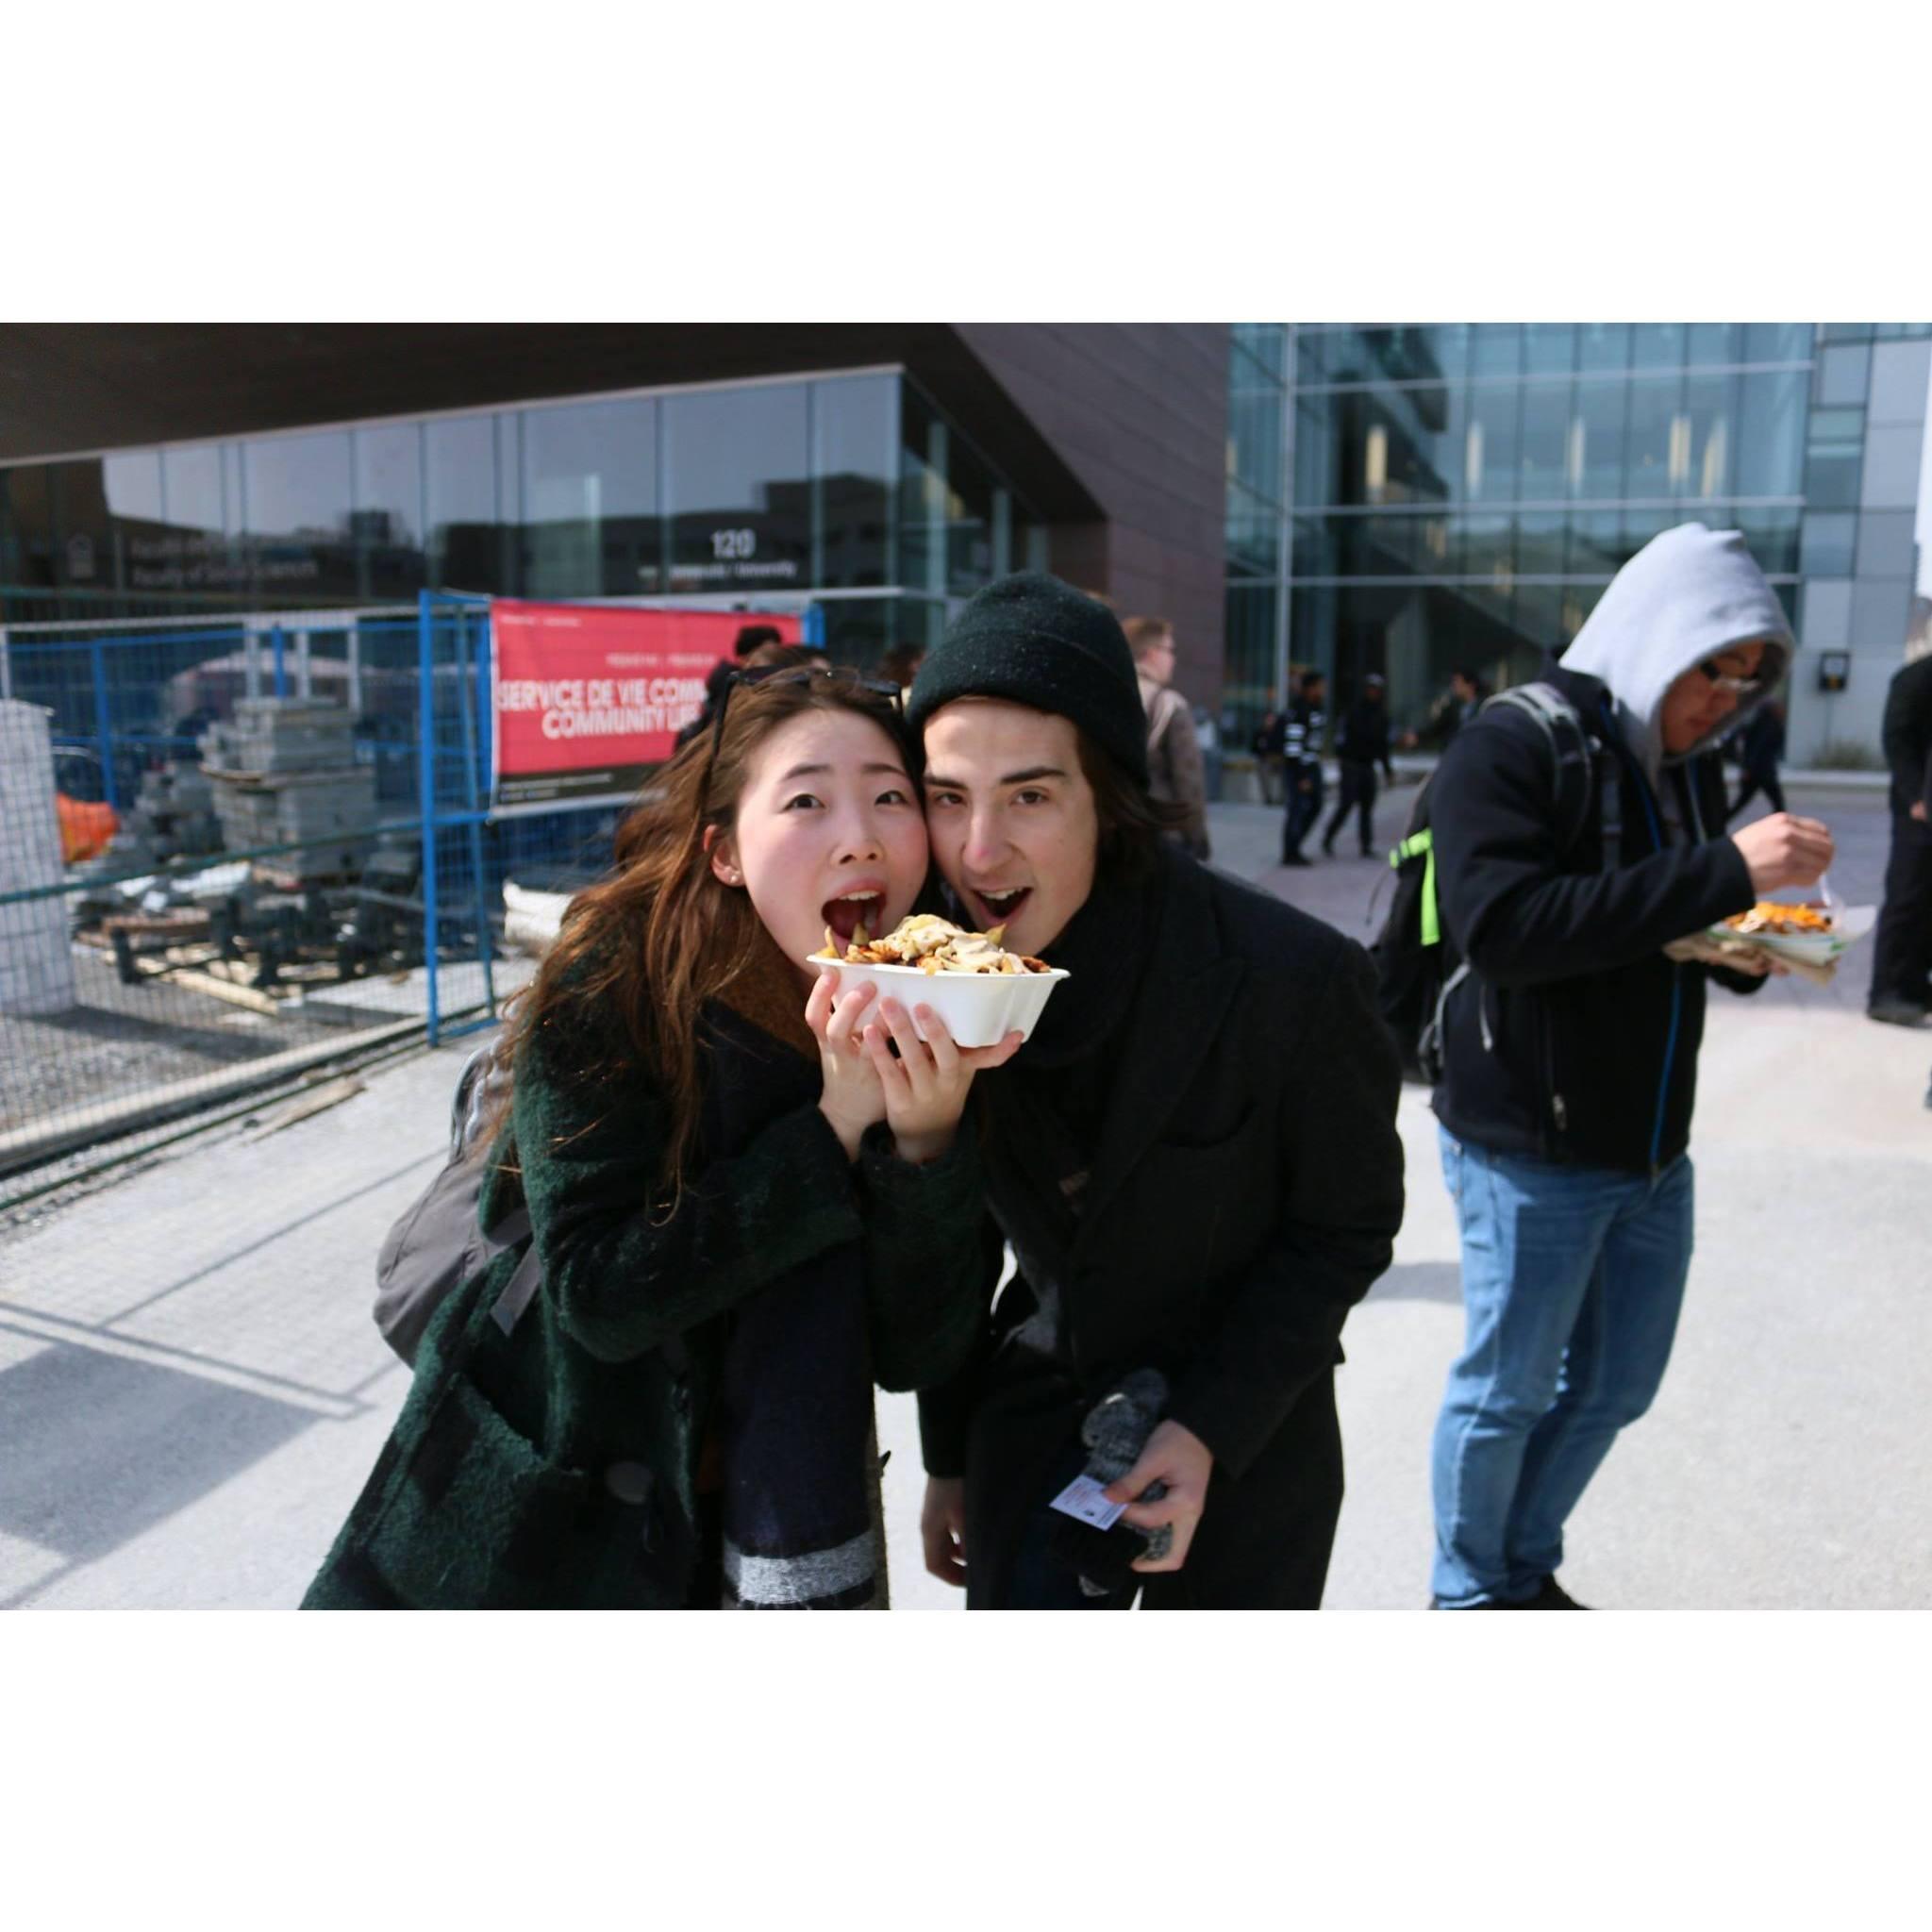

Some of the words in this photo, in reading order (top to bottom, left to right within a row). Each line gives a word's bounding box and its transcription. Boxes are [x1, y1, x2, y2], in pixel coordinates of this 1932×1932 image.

[711, 528, 755, 558] 120
[497, 679, 585, 711] SERVICE
[587, 678, 615, 708] DE
[617, 678, 647, 705] VIE
[541, 706, 666, 741] COMMUNITY
